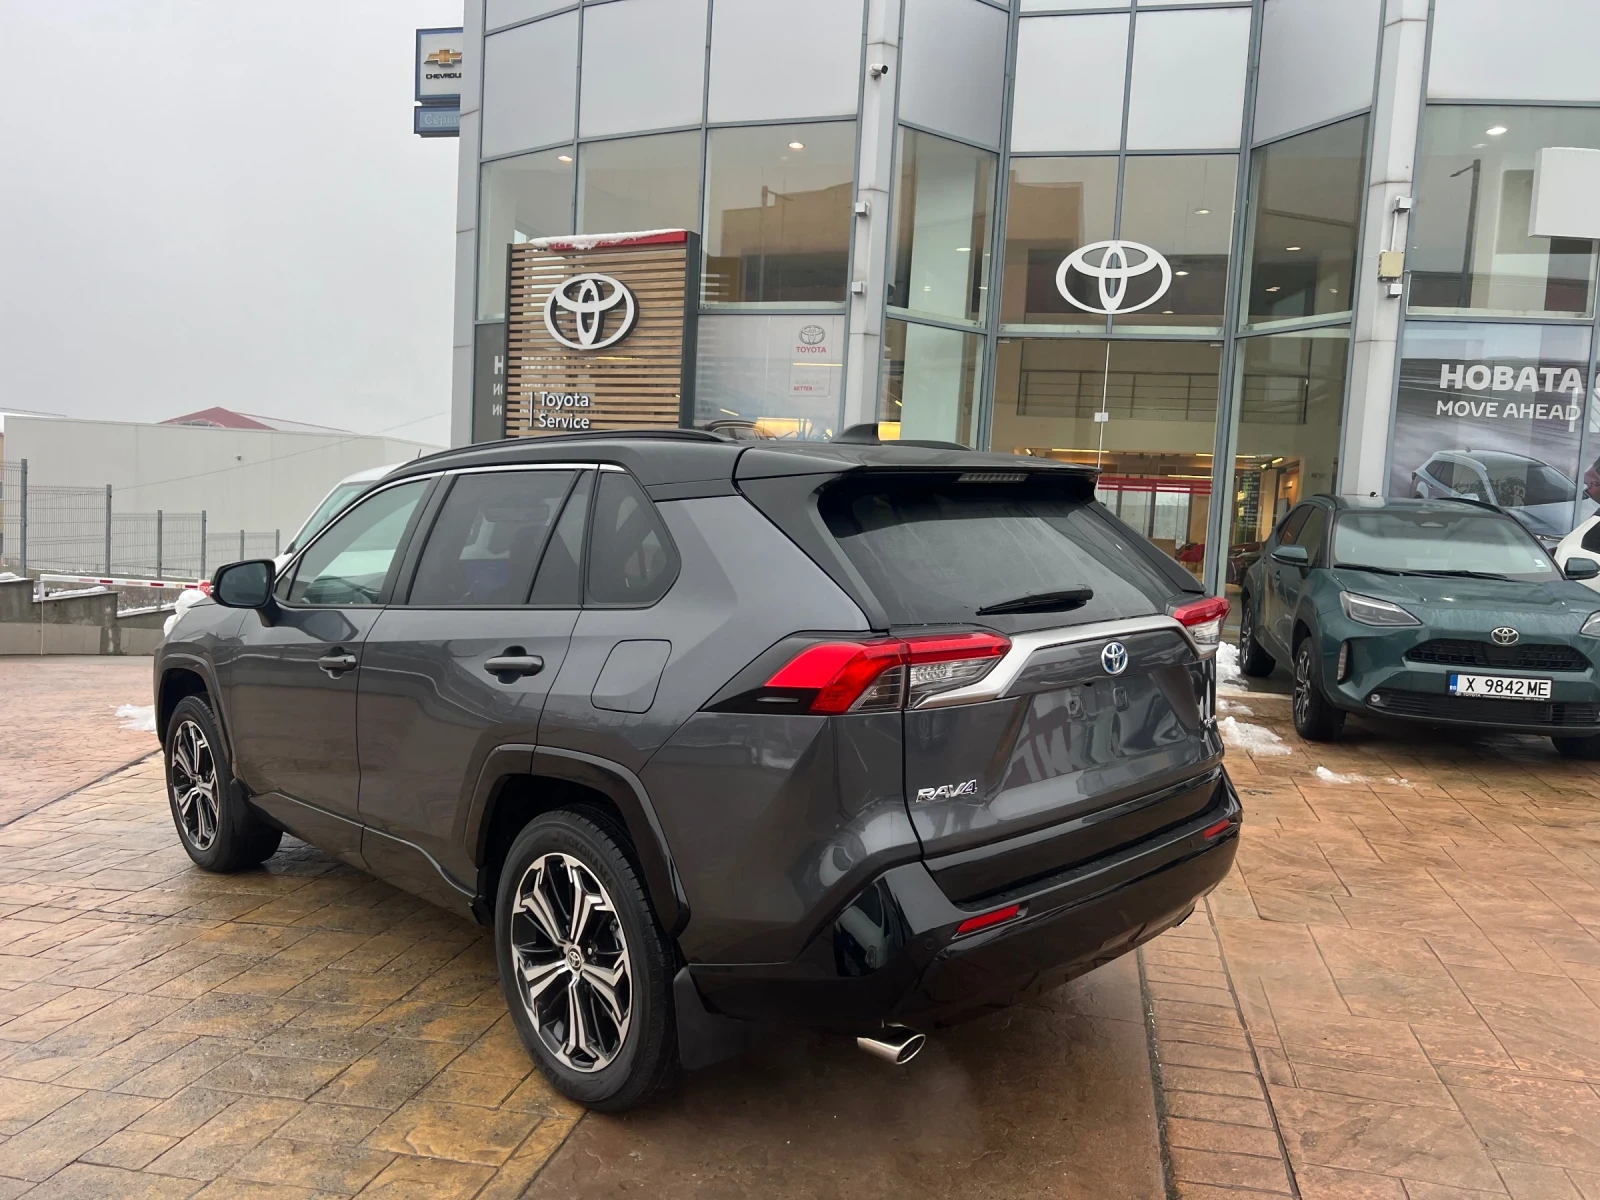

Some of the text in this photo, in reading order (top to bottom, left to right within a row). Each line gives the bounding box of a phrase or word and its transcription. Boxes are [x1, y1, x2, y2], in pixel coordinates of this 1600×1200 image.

[796, 346, 827, 354] TOYOTA
[539, 391, 590, 410] Toyota
[1436, 400, 1581, 421] MOVE AHEAD
[538, 412, 590, 429] Service
[1484, 678, 1524, 695] 9842
[1527, 681, 1549, 696] ME
[915, 779, 978, 803] RAV4
